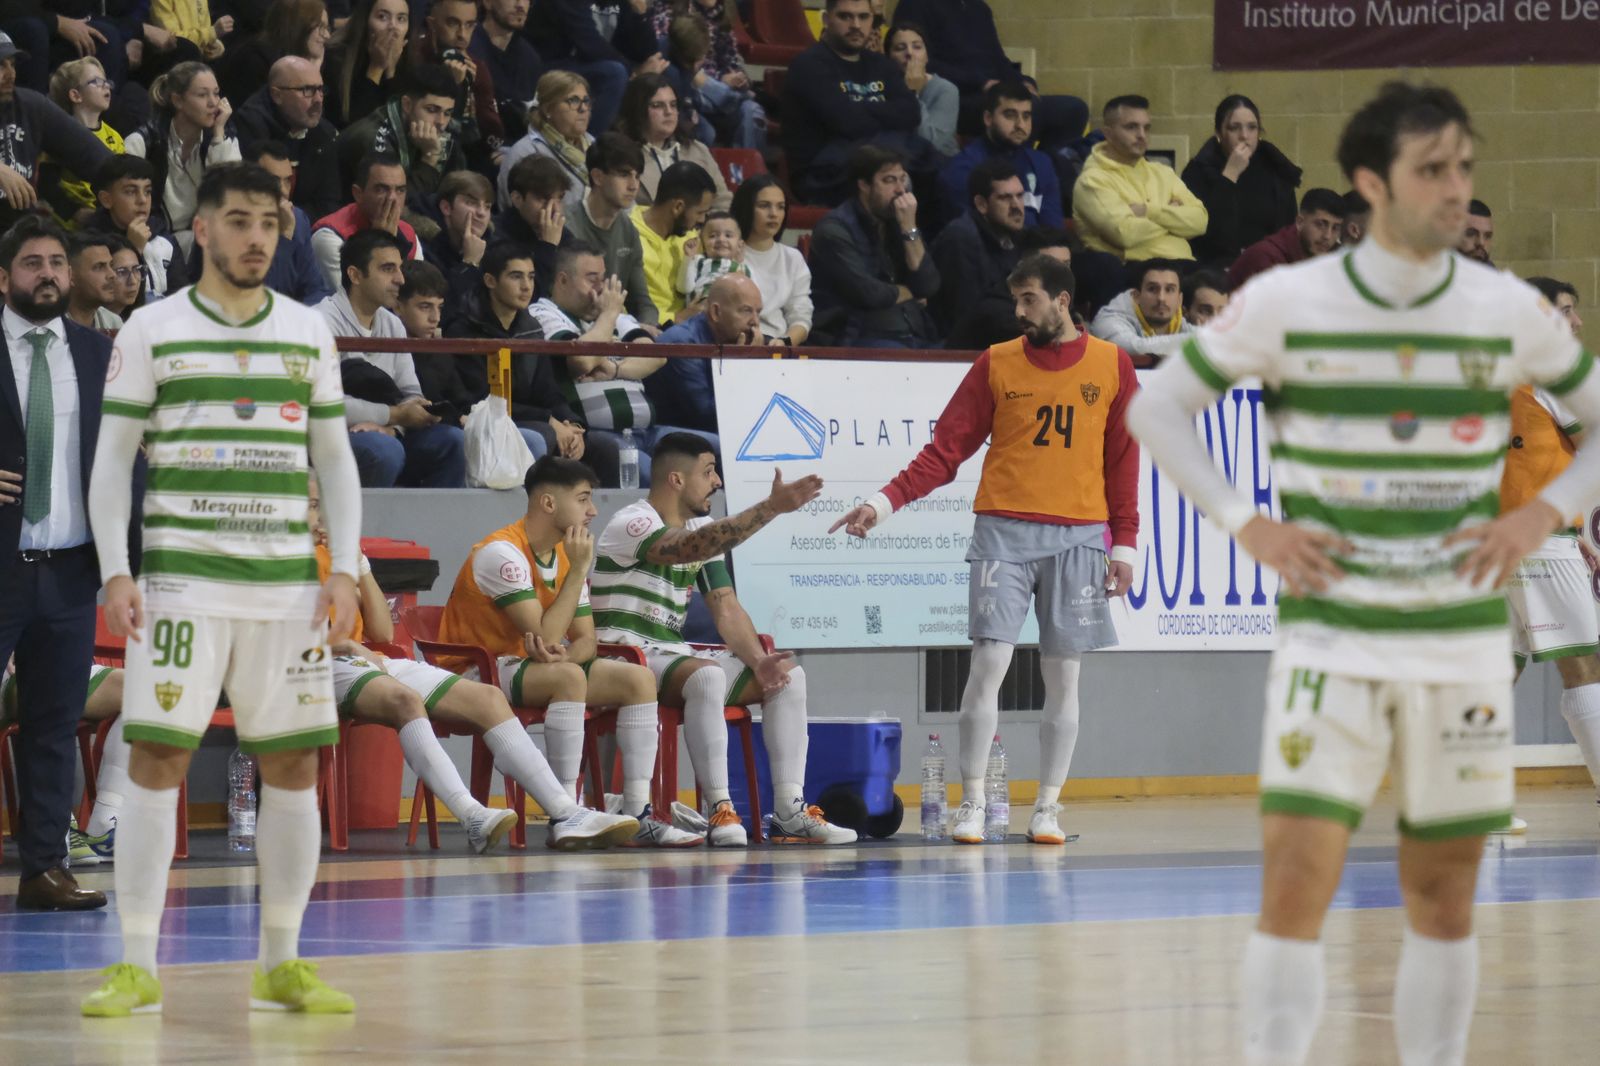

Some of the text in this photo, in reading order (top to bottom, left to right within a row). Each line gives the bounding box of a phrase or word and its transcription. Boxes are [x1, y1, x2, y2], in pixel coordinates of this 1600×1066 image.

[1243, 0, 1600, 30] Instituto Municipal de De
[829, 418, 992, 446] PLATE
[1033, 404, 1074, 449] 24
[190, 499, 277, 516] Mezquita-
[797, 496, 844, 516] ogados
[904, 496, 973, 513] Administrativ
[790, 535, 836, 550] Asesores
[846, 532, 933, 550] Administradores
[935, 532, 951, 550] de
[790, 574, 861, 587] TRANSPARENCIA
[866, 573, 947, 586] RESPONSABILIDAD
[980, 561, 1000, 588] 12
[929, 603, 970, 617] www.plate
[790, 616, 838, 629] 957 435 645
[1158, 614, 1206, 635] CORDOBESA
[1208, 614, 1219, 635] DE
[1221, 614, 1272, 635] COPIADORAS
[152, 618, 194, 669] 98
[1285, 667, 1327, 716] 14
